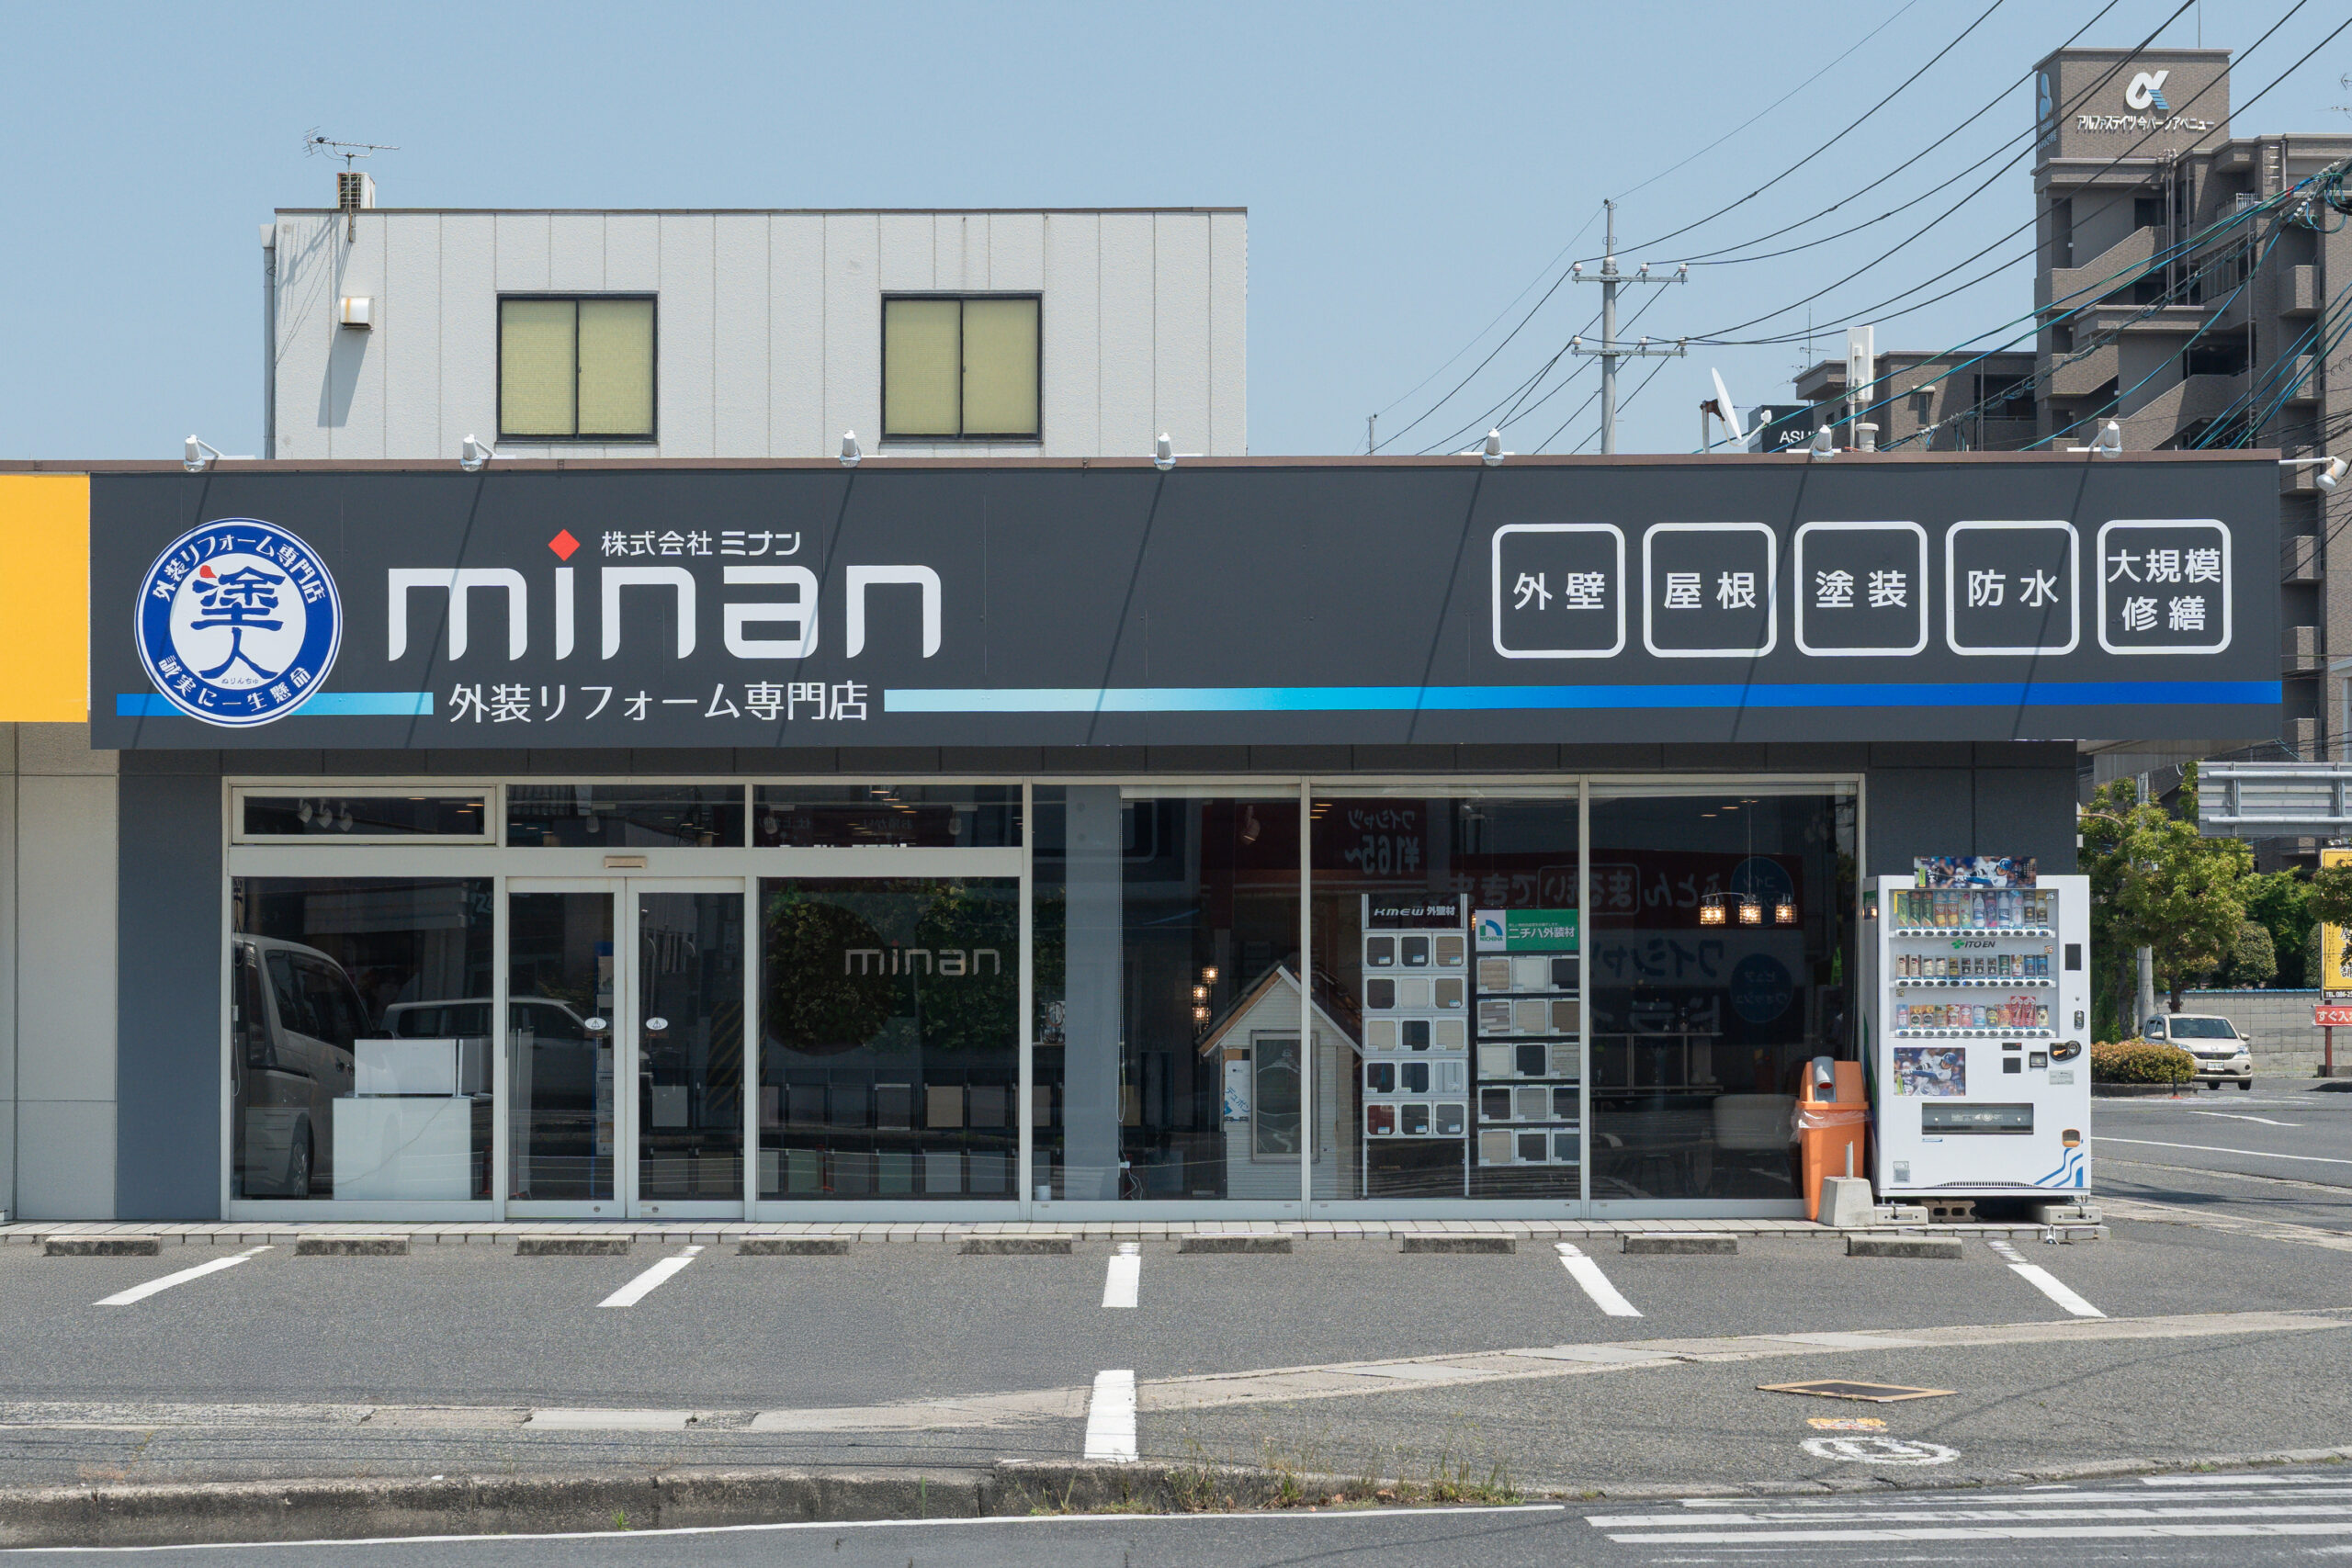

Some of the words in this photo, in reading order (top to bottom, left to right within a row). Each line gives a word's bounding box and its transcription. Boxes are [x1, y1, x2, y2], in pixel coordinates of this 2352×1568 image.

[601, 531, 713, 557] 株式会社
[720, 531, 801, 557] ミナン
[153, 534, 325, 604] 外装リフォーム専門店
[2107, 548, 2222, 583] 大規模
[389, 529, 942, 661] minan
[1513, 572, 1605, 611] 外壁
[1664, 571, 1758, 610] 屋根
[1815, 570, 1908, 608] 塗装
[1967, 569, 2059, 608] 防水
[2121, 595, 2207, 631] 修繕
[158, 655, 311, 712] 誠実に一生懸命
[448, 680, 869, 724] 外装リフォーム専門店
[1508, 926, 1575, 939] ニチハ外装材
[1983, 940, 1996, 948] EN
[844, 940, 1001, 976] minan
